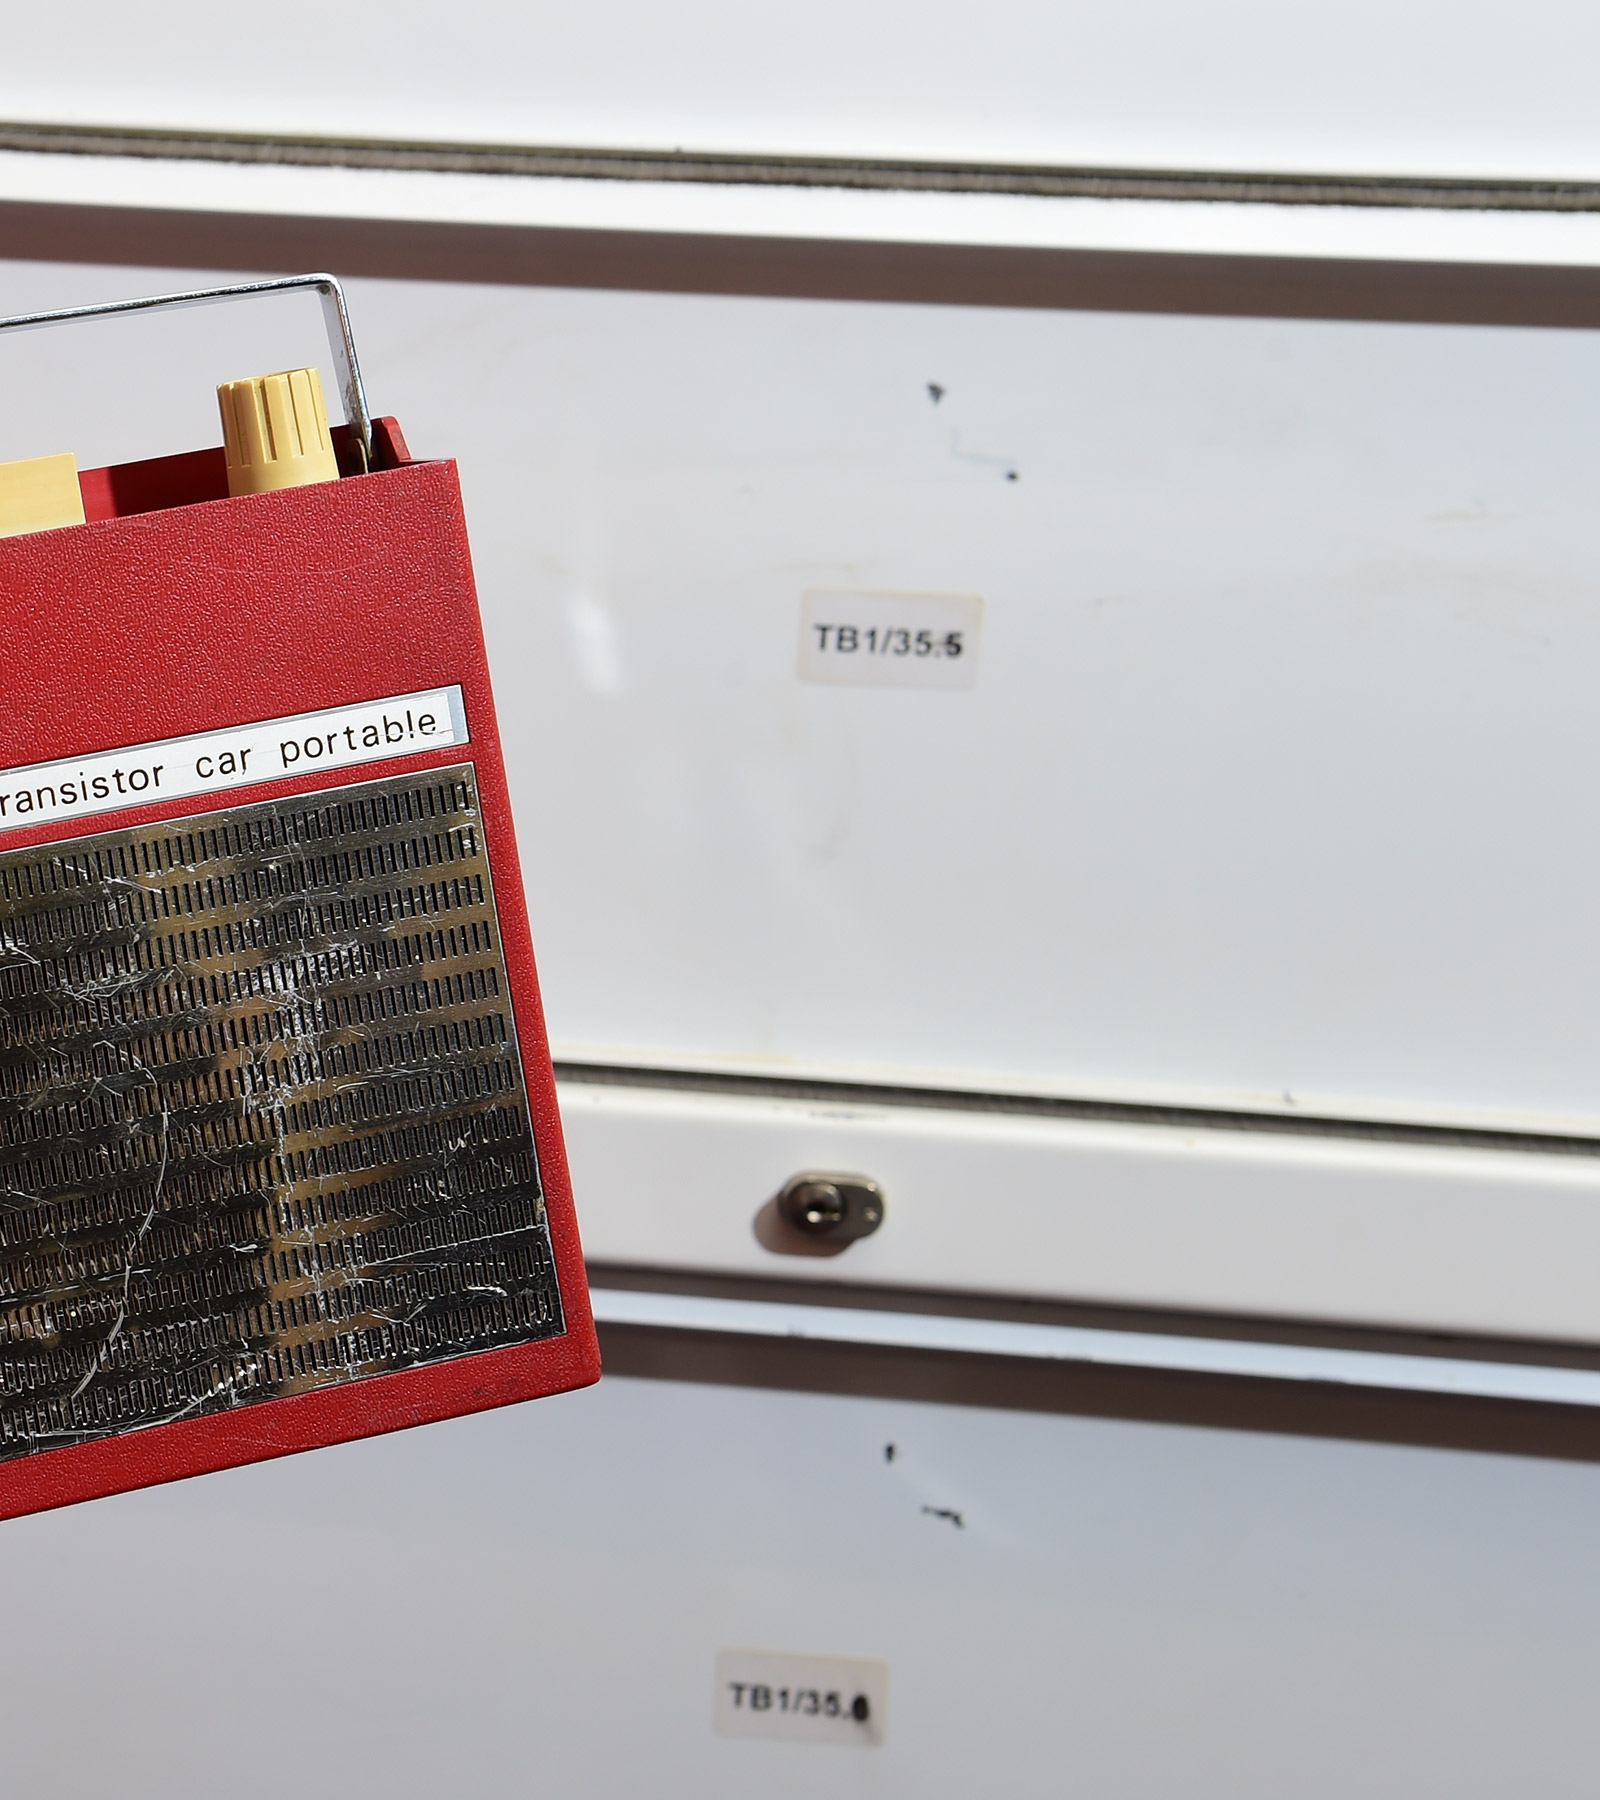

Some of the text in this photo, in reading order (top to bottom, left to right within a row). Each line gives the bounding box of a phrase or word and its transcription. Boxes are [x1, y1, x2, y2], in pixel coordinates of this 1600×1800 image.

[813, 623, 965, 660] TB1/35.5
[196, 746, 252, 779] car
[280, 709, 437, 769] portable
